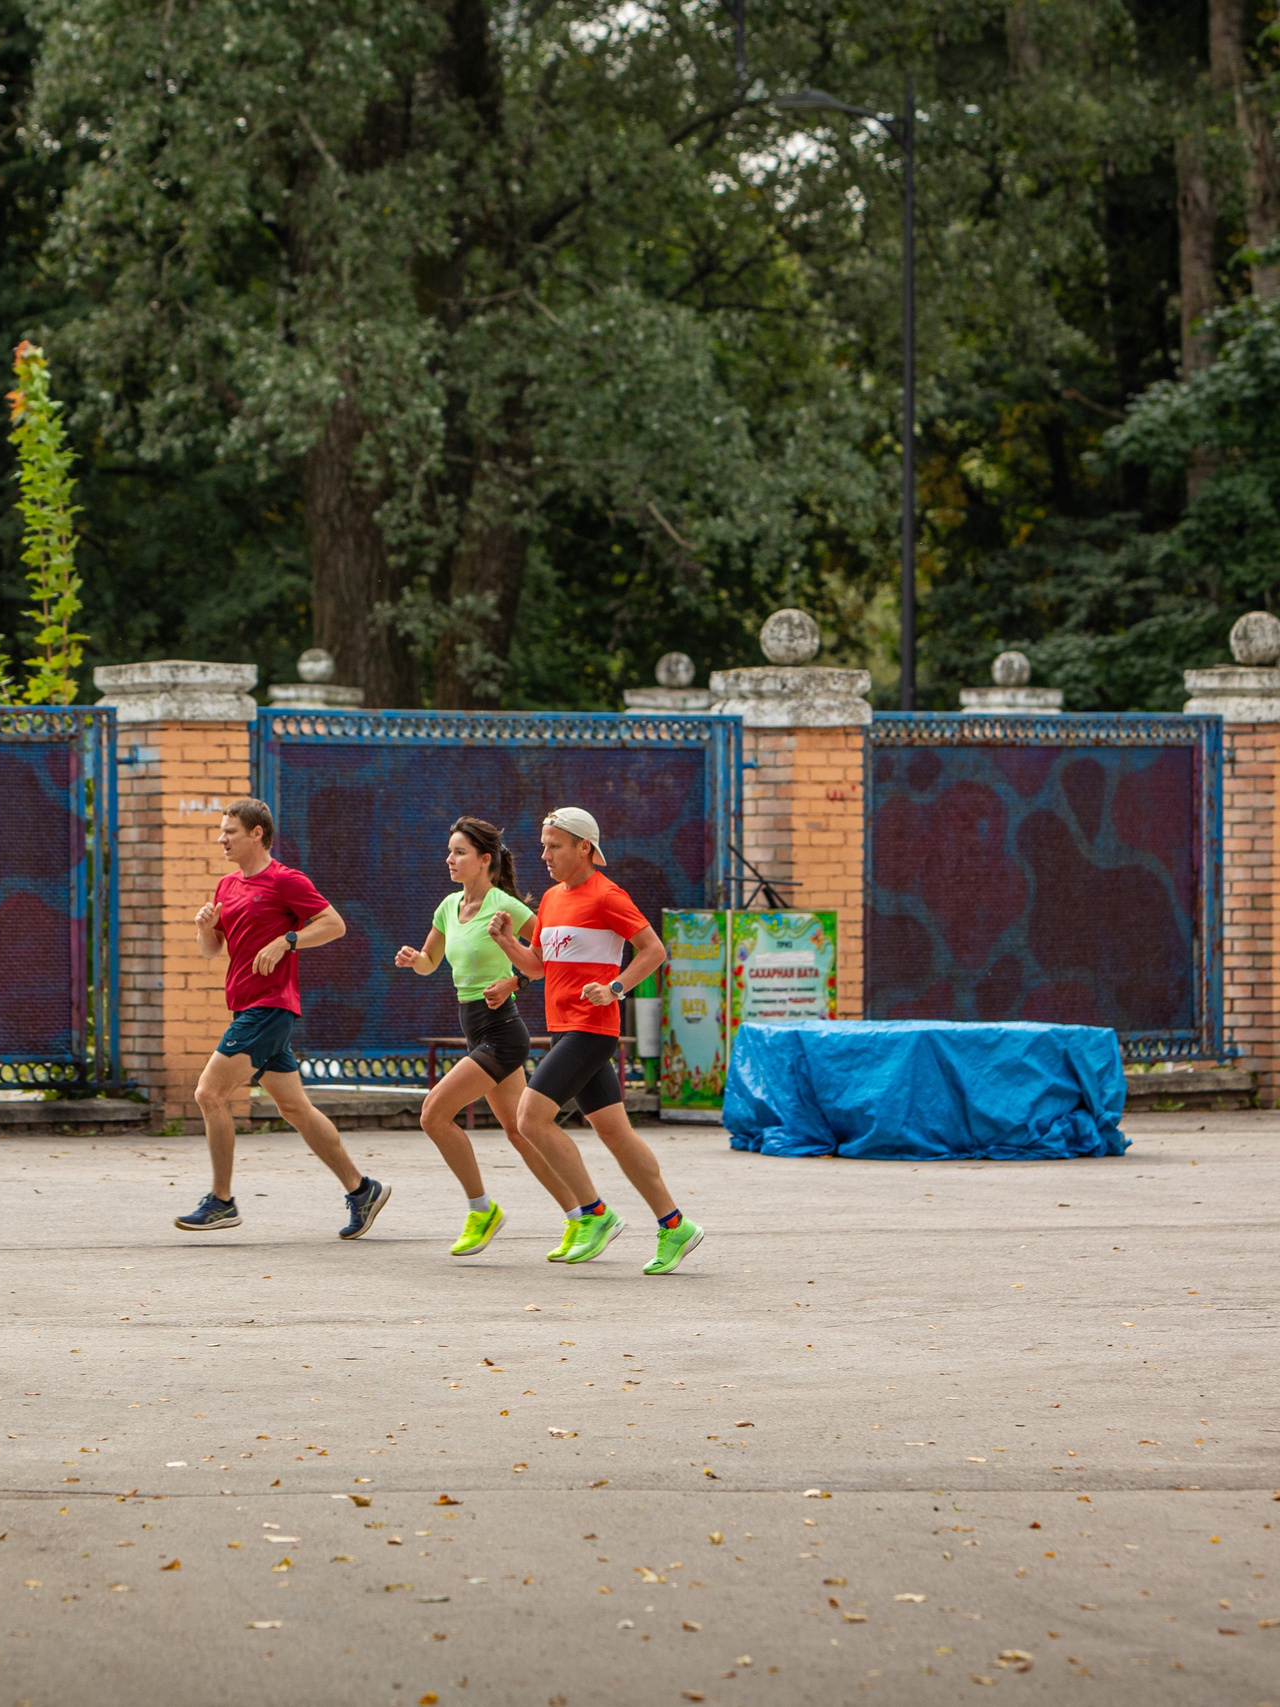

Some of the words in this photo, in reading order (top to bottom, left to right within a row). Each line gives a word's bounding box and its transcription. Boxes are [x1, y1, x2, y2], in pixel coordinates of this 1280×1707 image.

[667, 970, 722, 987] САХАРНАЯ
[748, 968, 795, 978] САХАРНАЯ
[797, 968, 820, 978] ВАТА
[681, 999, 708, 1016] ВАТА
